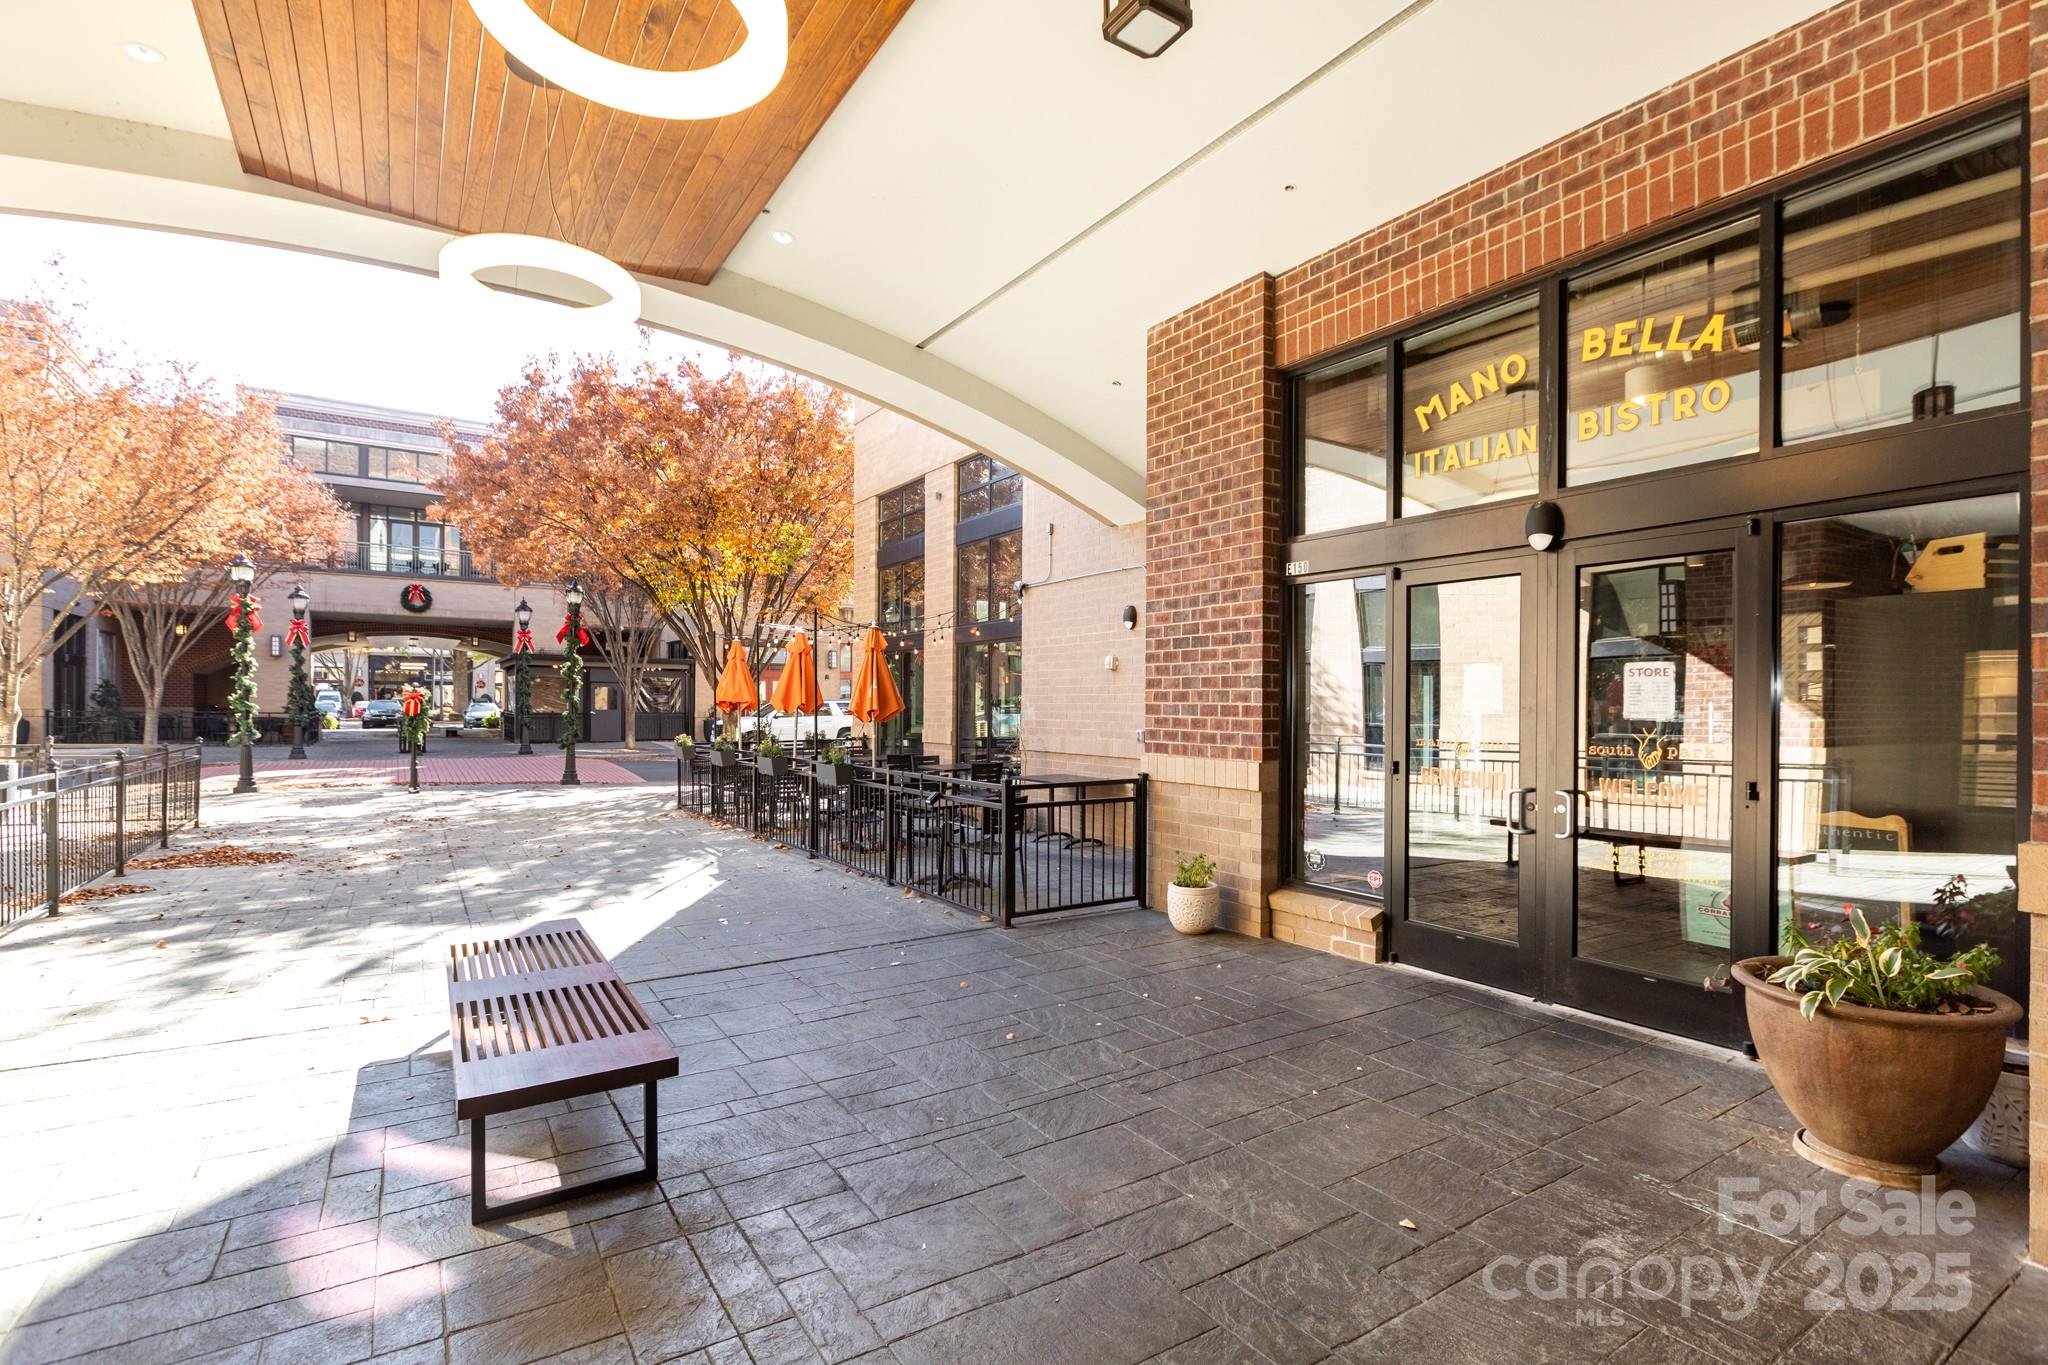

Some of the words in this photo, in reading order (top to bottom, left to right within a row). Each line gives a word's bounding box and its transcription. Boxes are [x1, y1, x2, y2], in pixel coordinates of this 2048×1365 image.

[1414, 354, 1527, 432] MANO
[1581, 314, 1726, 362] BELLA
[1414, 425, 1537, 477] ITALIAN
[1577, 379, 1732, 442] BISTRO
[1628, 667, 1671, 678] STORE
[1588, 744, 1635, 757] south
[1599, 777, 1708, 807] WELCOME
